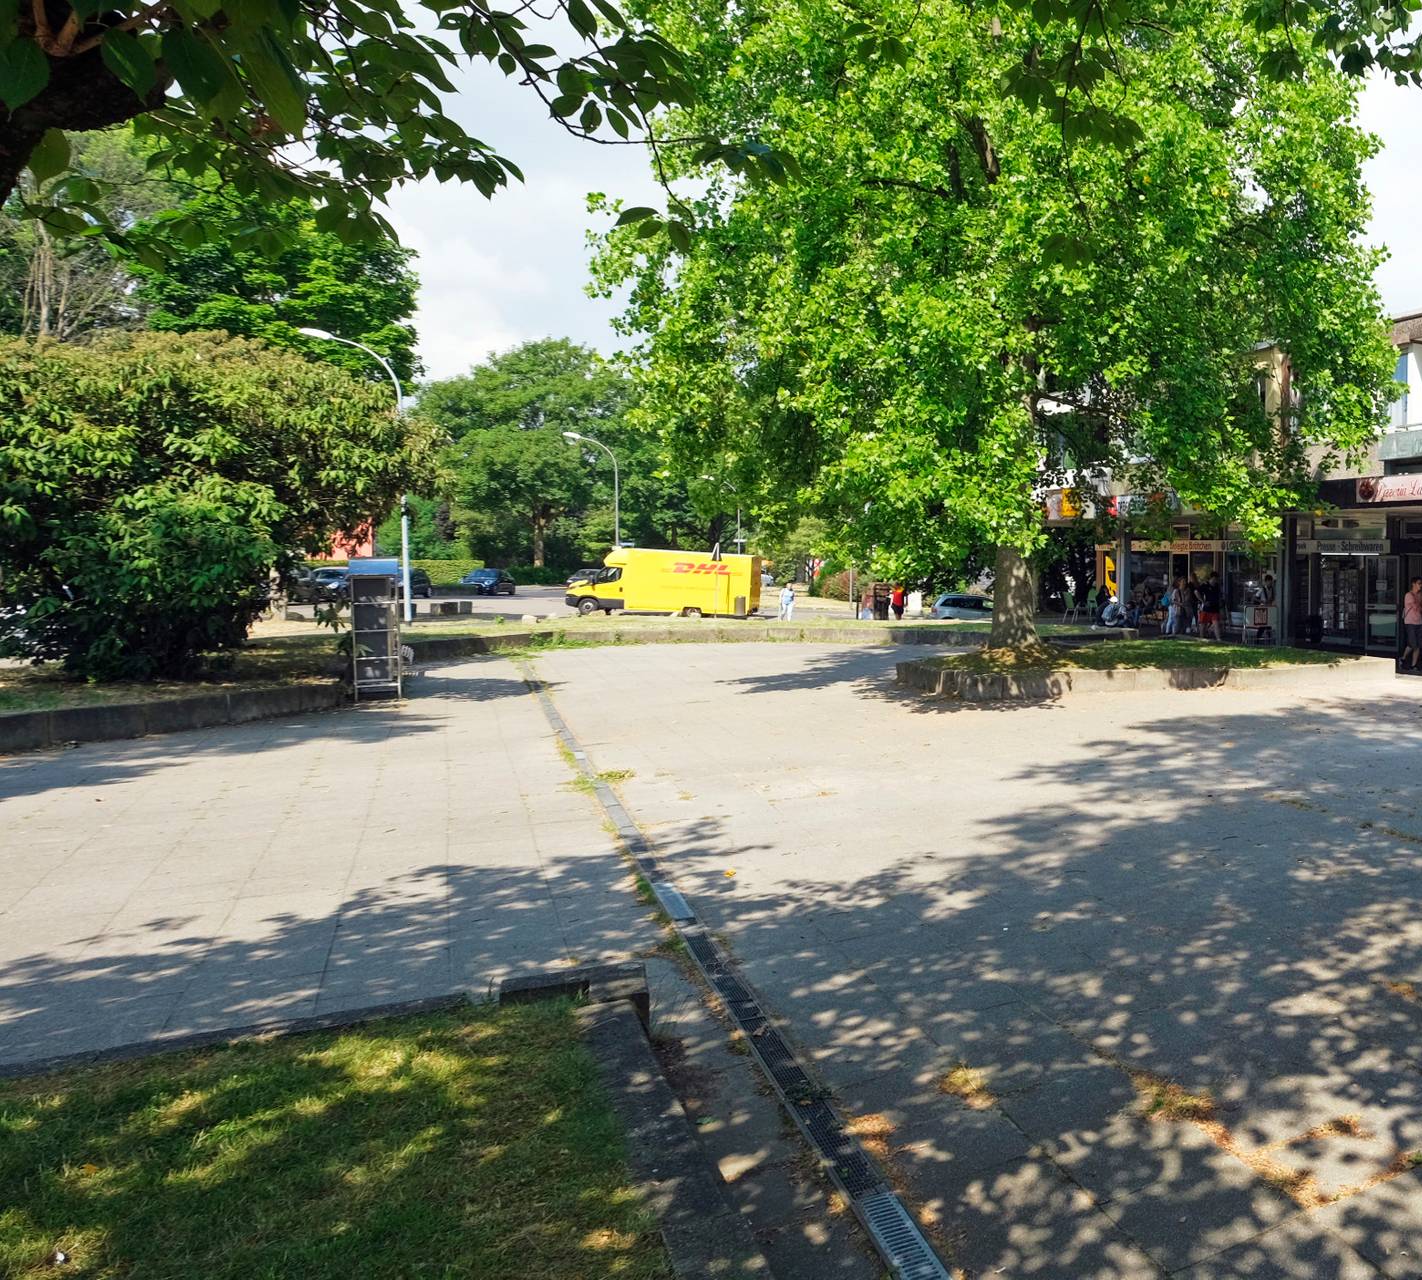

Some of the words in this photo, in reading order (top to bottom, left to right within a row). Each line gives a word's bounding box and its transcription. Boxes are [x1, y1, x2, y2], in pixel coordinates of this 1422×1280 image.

[1409, 480, 1422, 496] La
[1317, 540, 1336, 551] Presse
[1341, 540, 1384, 552] Schreibwaren
[673, 562, 731, 576] DHL
